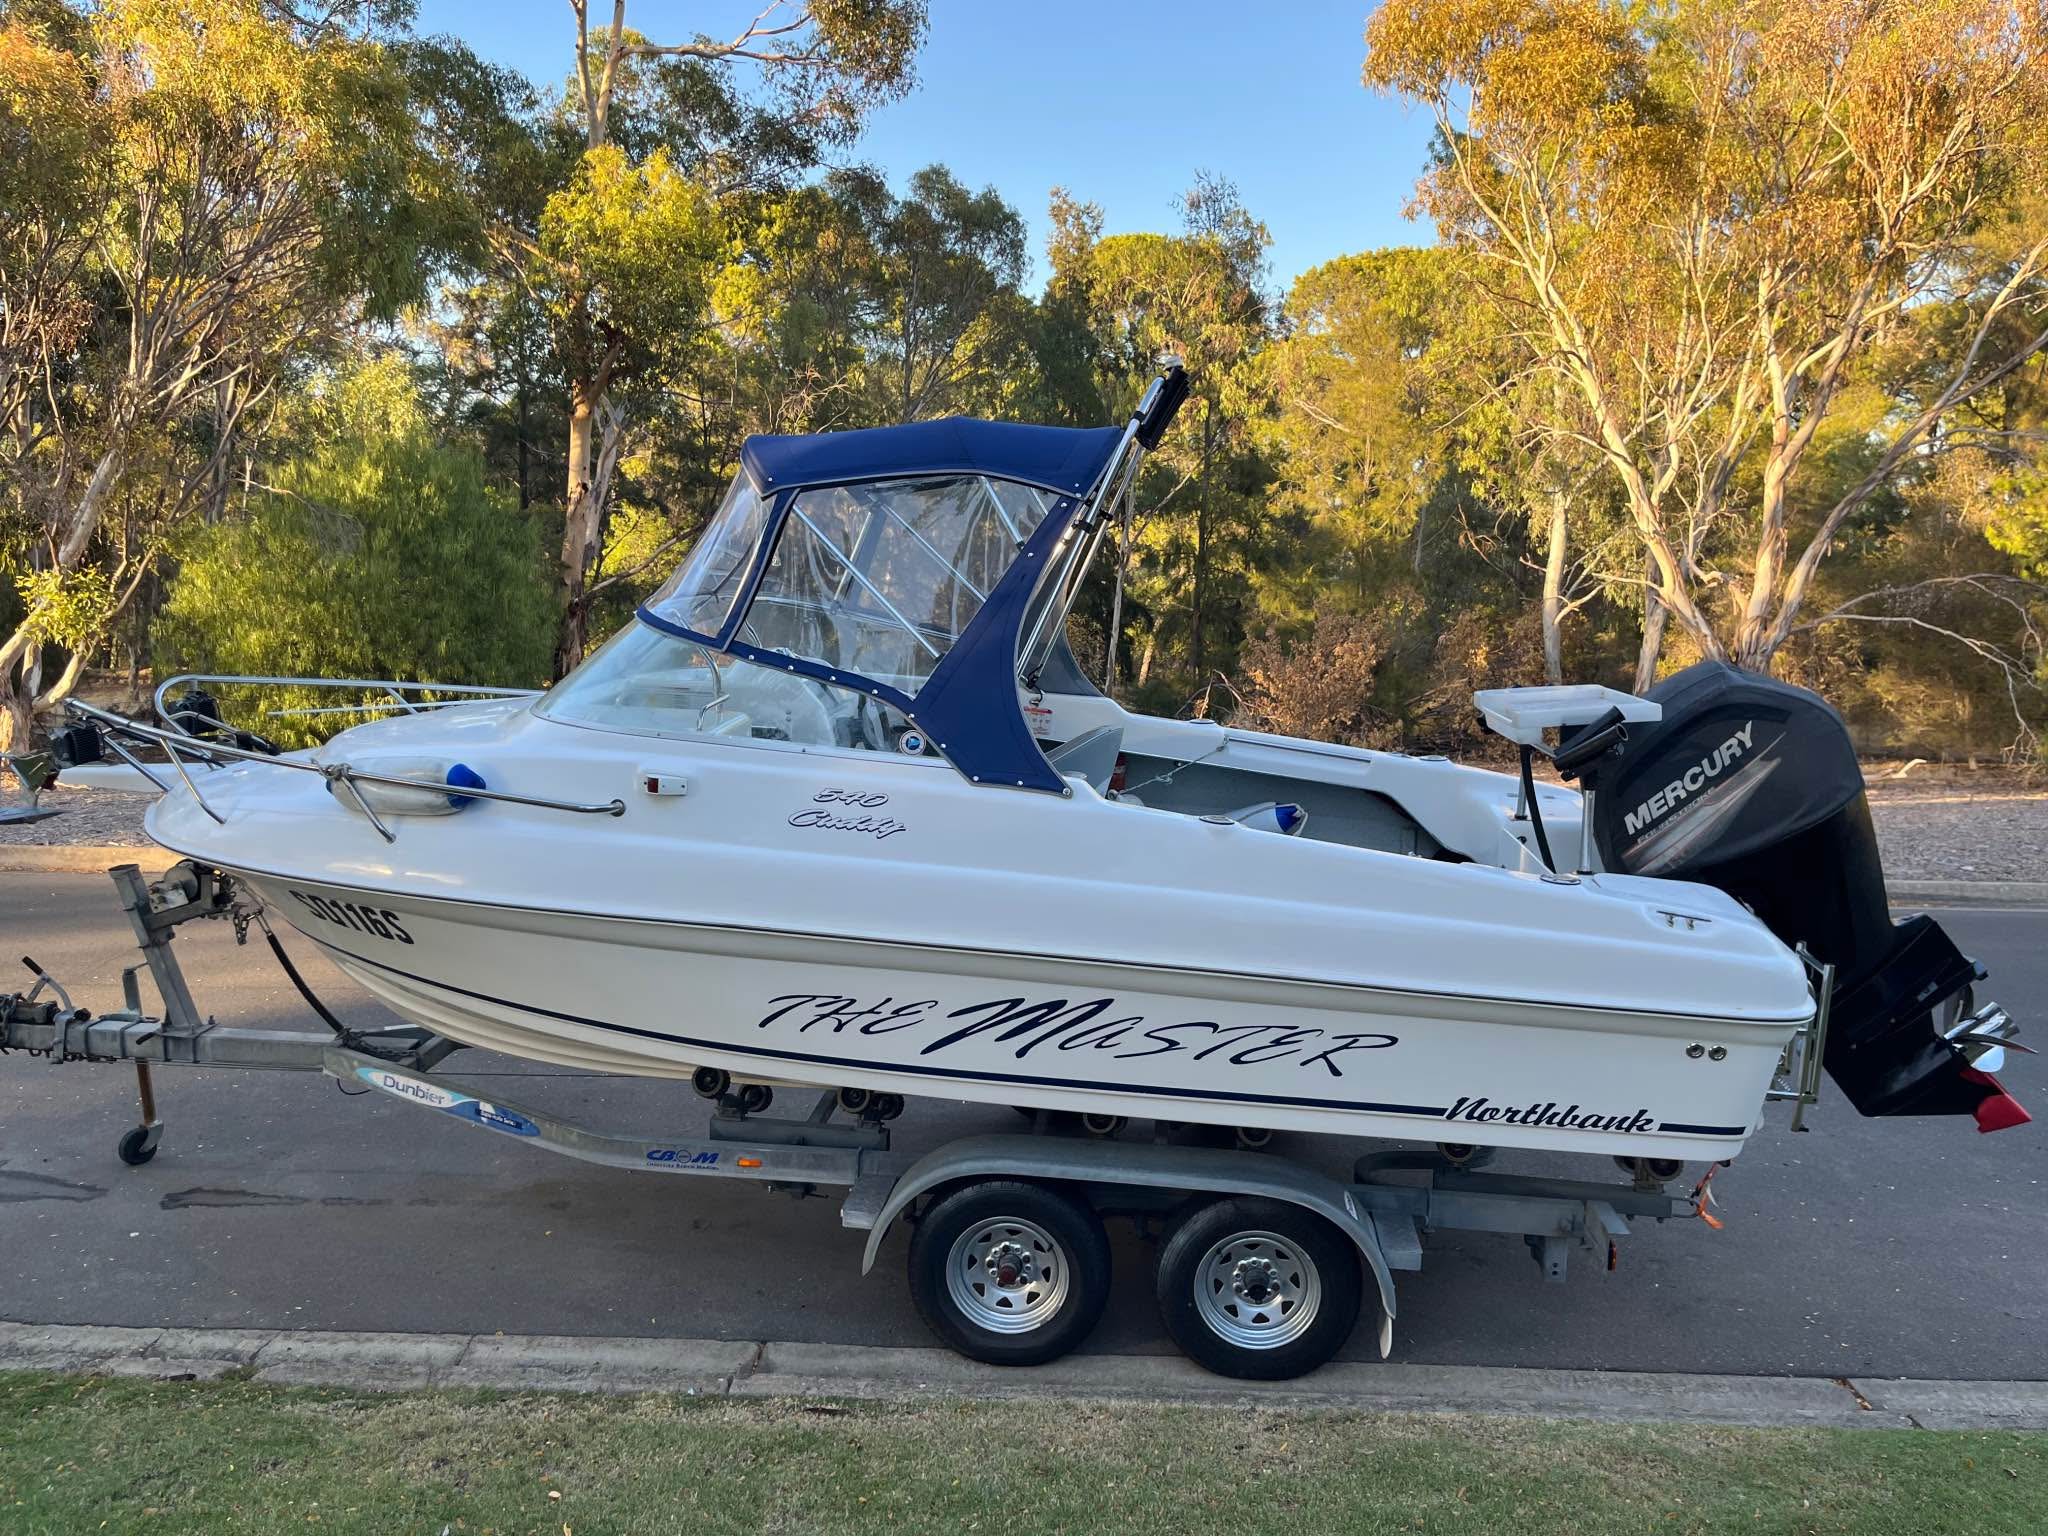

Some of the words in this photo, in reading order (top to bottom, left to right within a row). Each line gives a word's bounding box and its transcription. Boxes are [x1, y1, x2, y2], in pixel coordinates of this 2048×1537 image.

[1624, 720, 1752, 835] MERCURY
[813, 787, 888, 807] 540
[788, 808, 907, 839] Cuddy
[758, 994, 939, 1036] THE
[383, 1074, 446, 1105] Dunbier
[1445, 1096, 1655, 1133] Northbank
